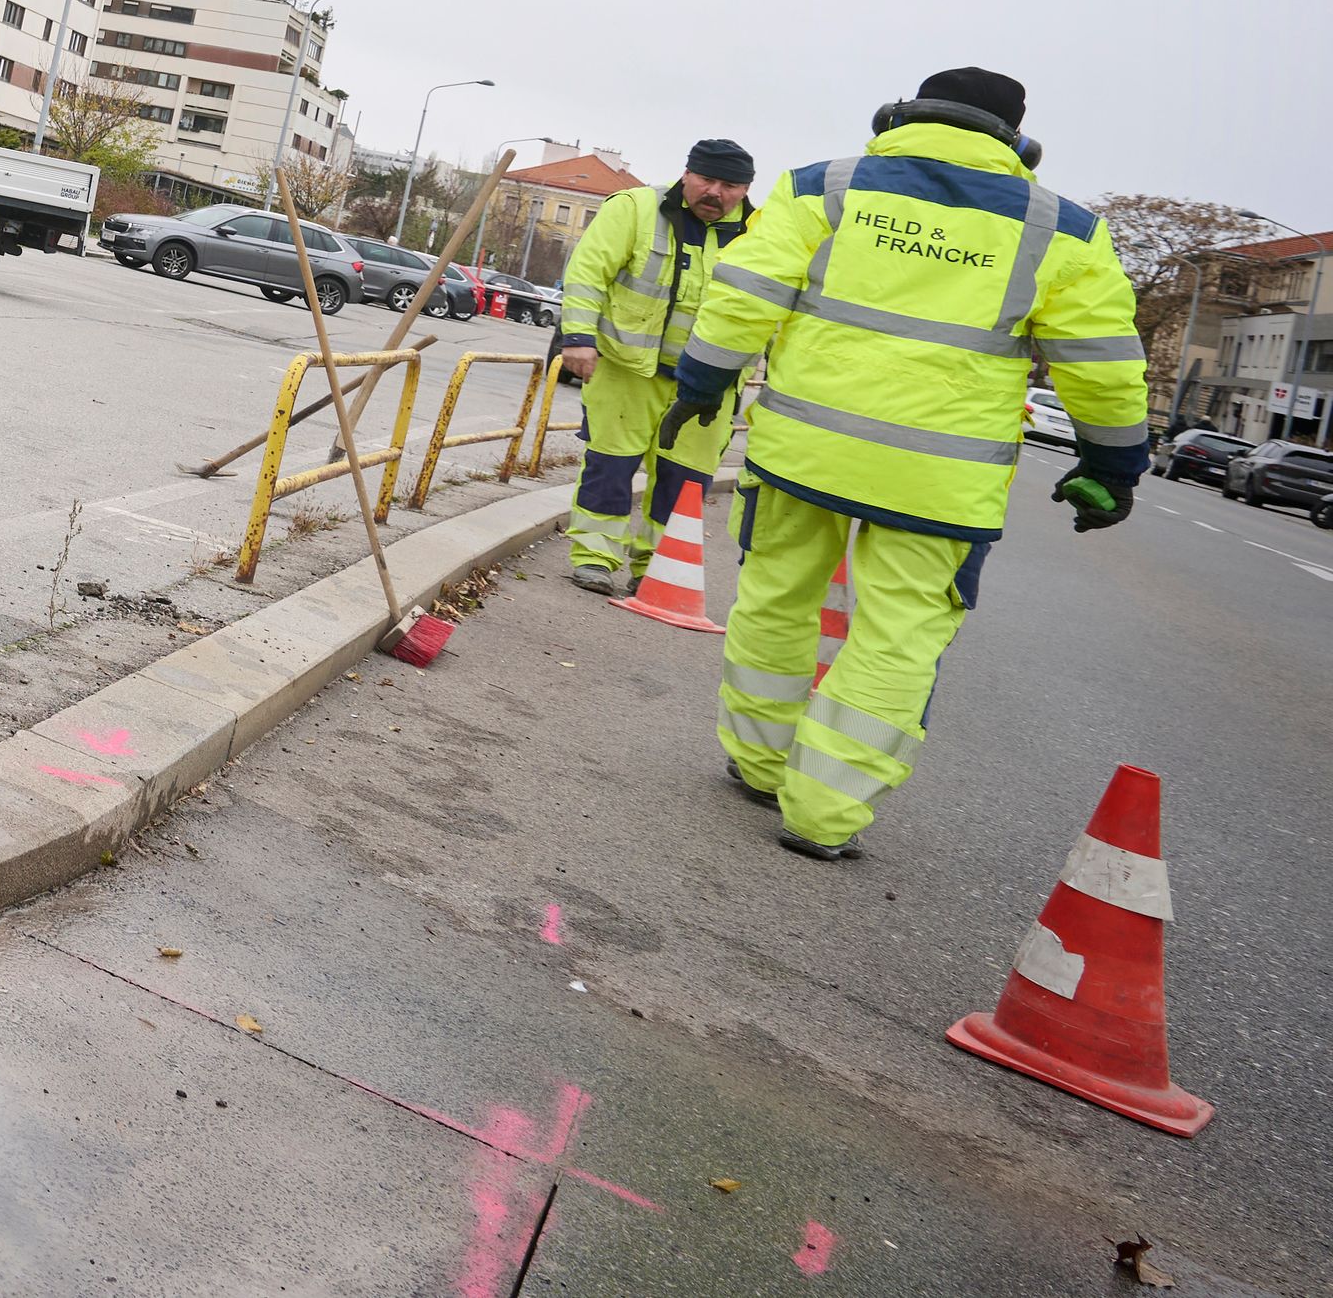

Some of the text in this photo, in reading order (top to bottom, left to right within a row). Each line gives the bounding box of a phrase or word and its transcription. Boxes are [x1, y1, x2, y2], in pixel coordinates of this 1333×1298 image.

[60, 192, 80, 200] GROUP
[61, 187, 81, 196] HABAU
[855, 210, 947, 241] HELD &
[875, 234, 996, 268] FRANCKE
